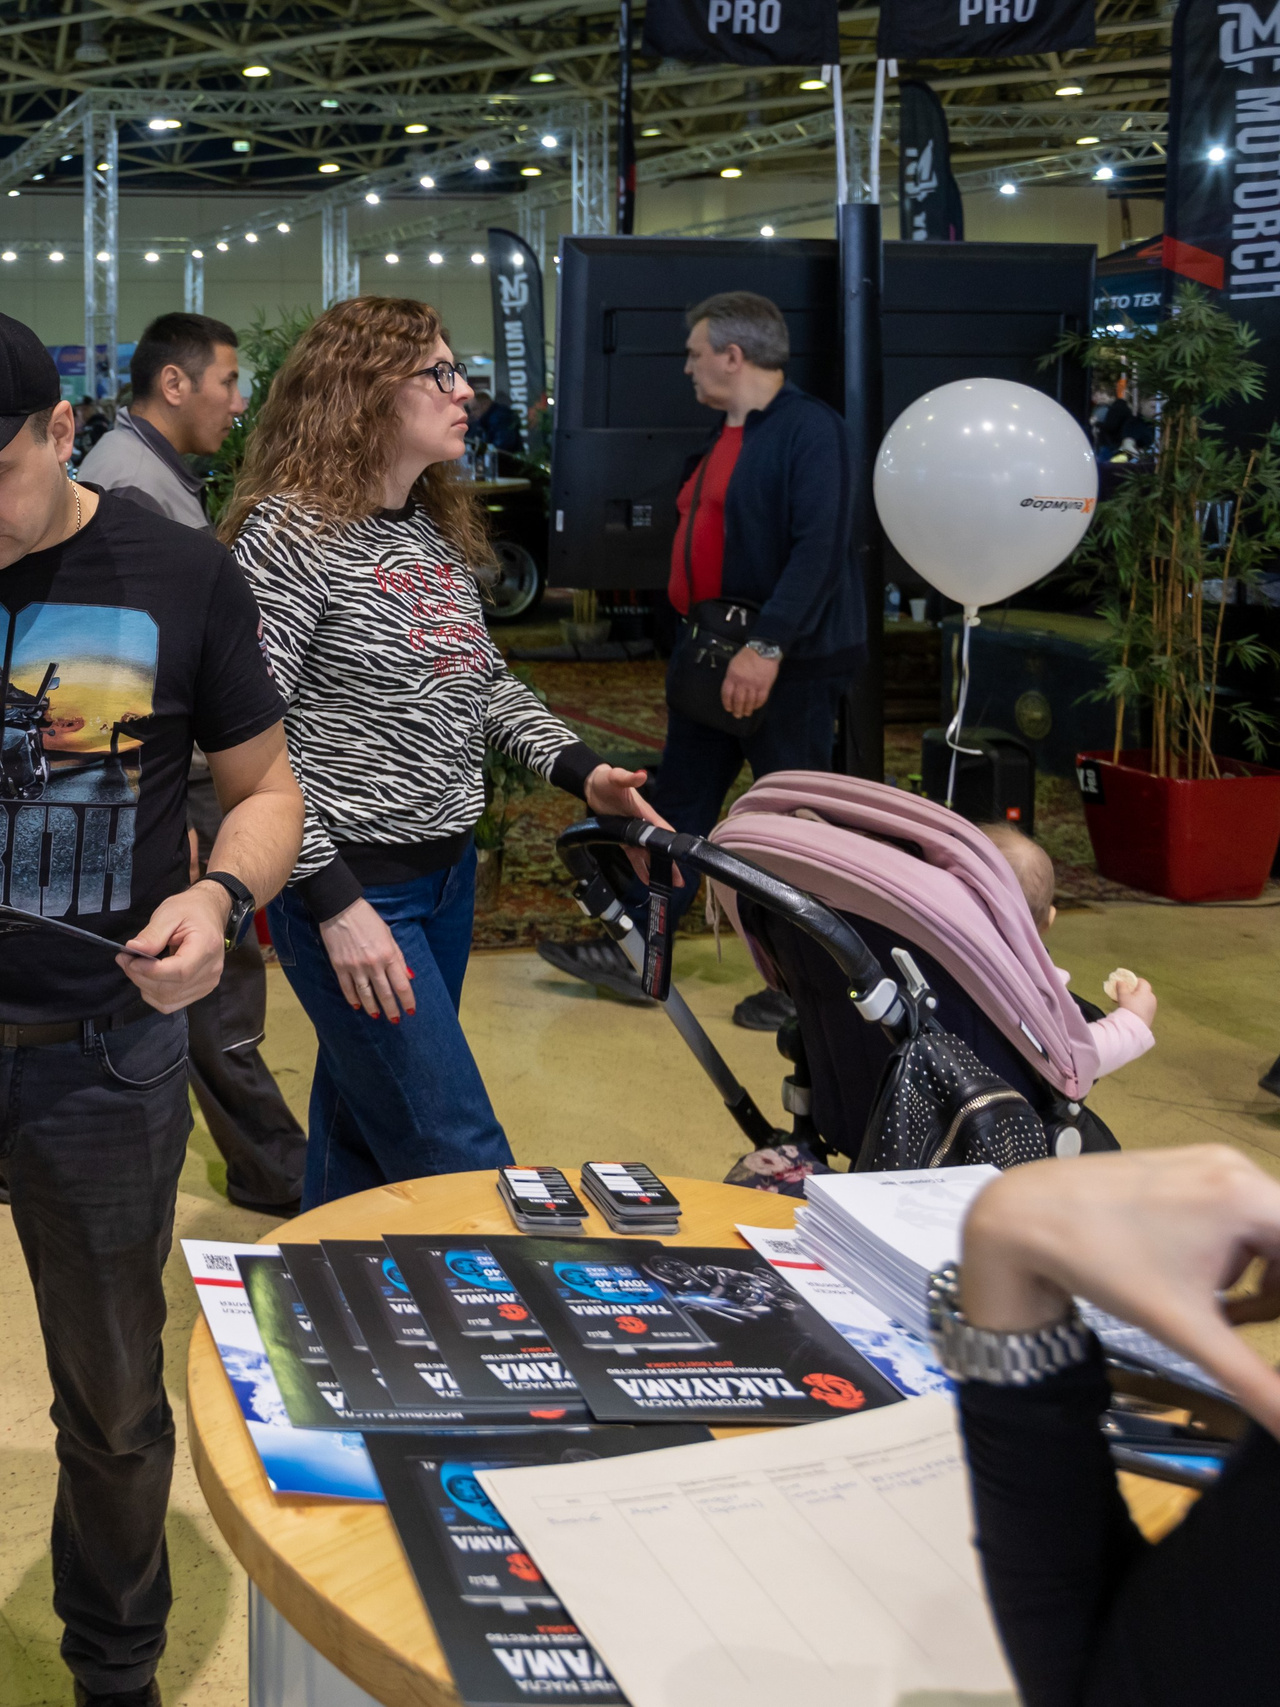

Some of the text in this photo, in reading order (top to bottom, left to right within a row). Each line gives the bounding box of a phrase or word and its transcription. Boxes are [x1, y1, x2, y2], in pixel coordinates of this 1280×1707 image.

[708, 0, 781, 34] PRO
[1133, 292, 1161, 307] TEX
[568, 1304, 672, 1316] TAKAYAMA
[606, 1367, 657, 1375] КАЧЕСТВО
[612, 1377, 806, 1398] TAKAYAMA
[634, 1397, 763, 1408] МОТОРНЫЕ МАСЛА
